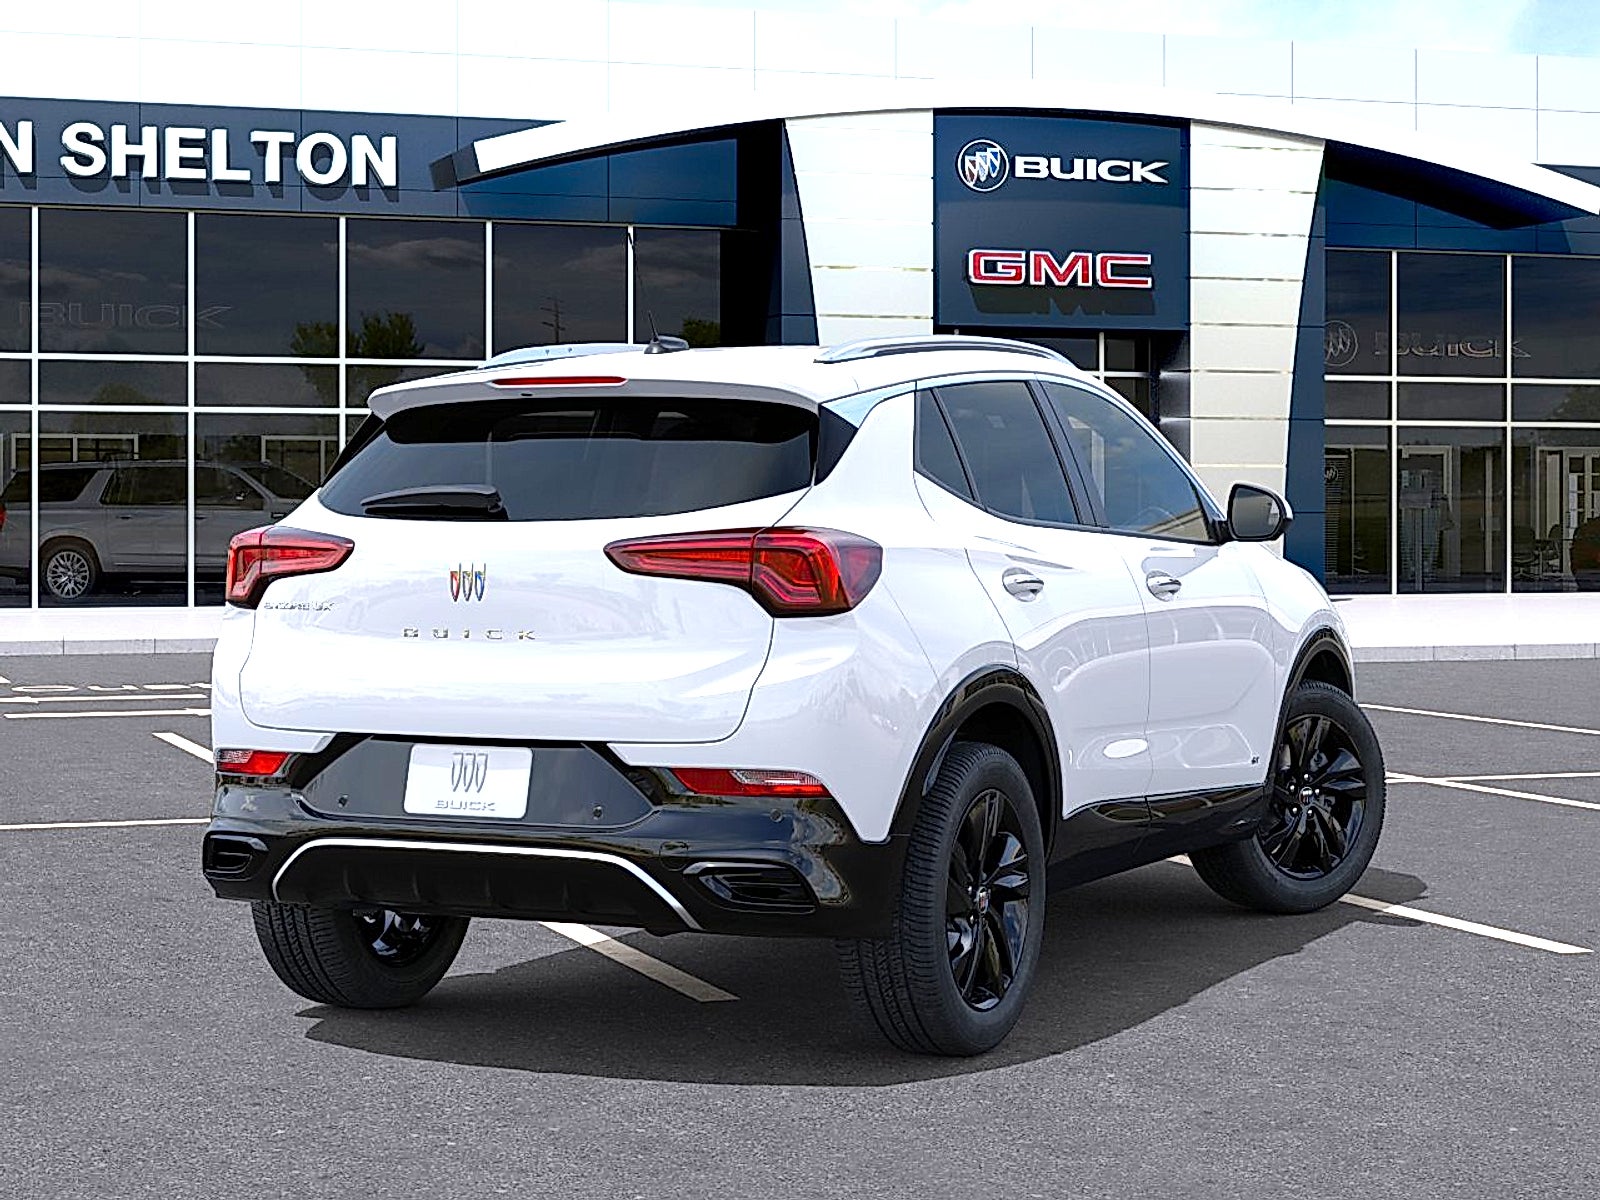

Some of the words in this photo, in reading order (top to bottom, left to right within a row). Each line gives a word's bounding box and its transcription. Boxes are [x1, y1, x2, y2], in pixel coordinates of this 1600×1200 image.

[60, 121, 397, 187] SHELTON
[1014, 155, 1170, 184] BUICK
[968, 248, 1153, 289] GMC
[403, 627, 536, 641] BUICK
[435, 799, 496, 812] BUICK
